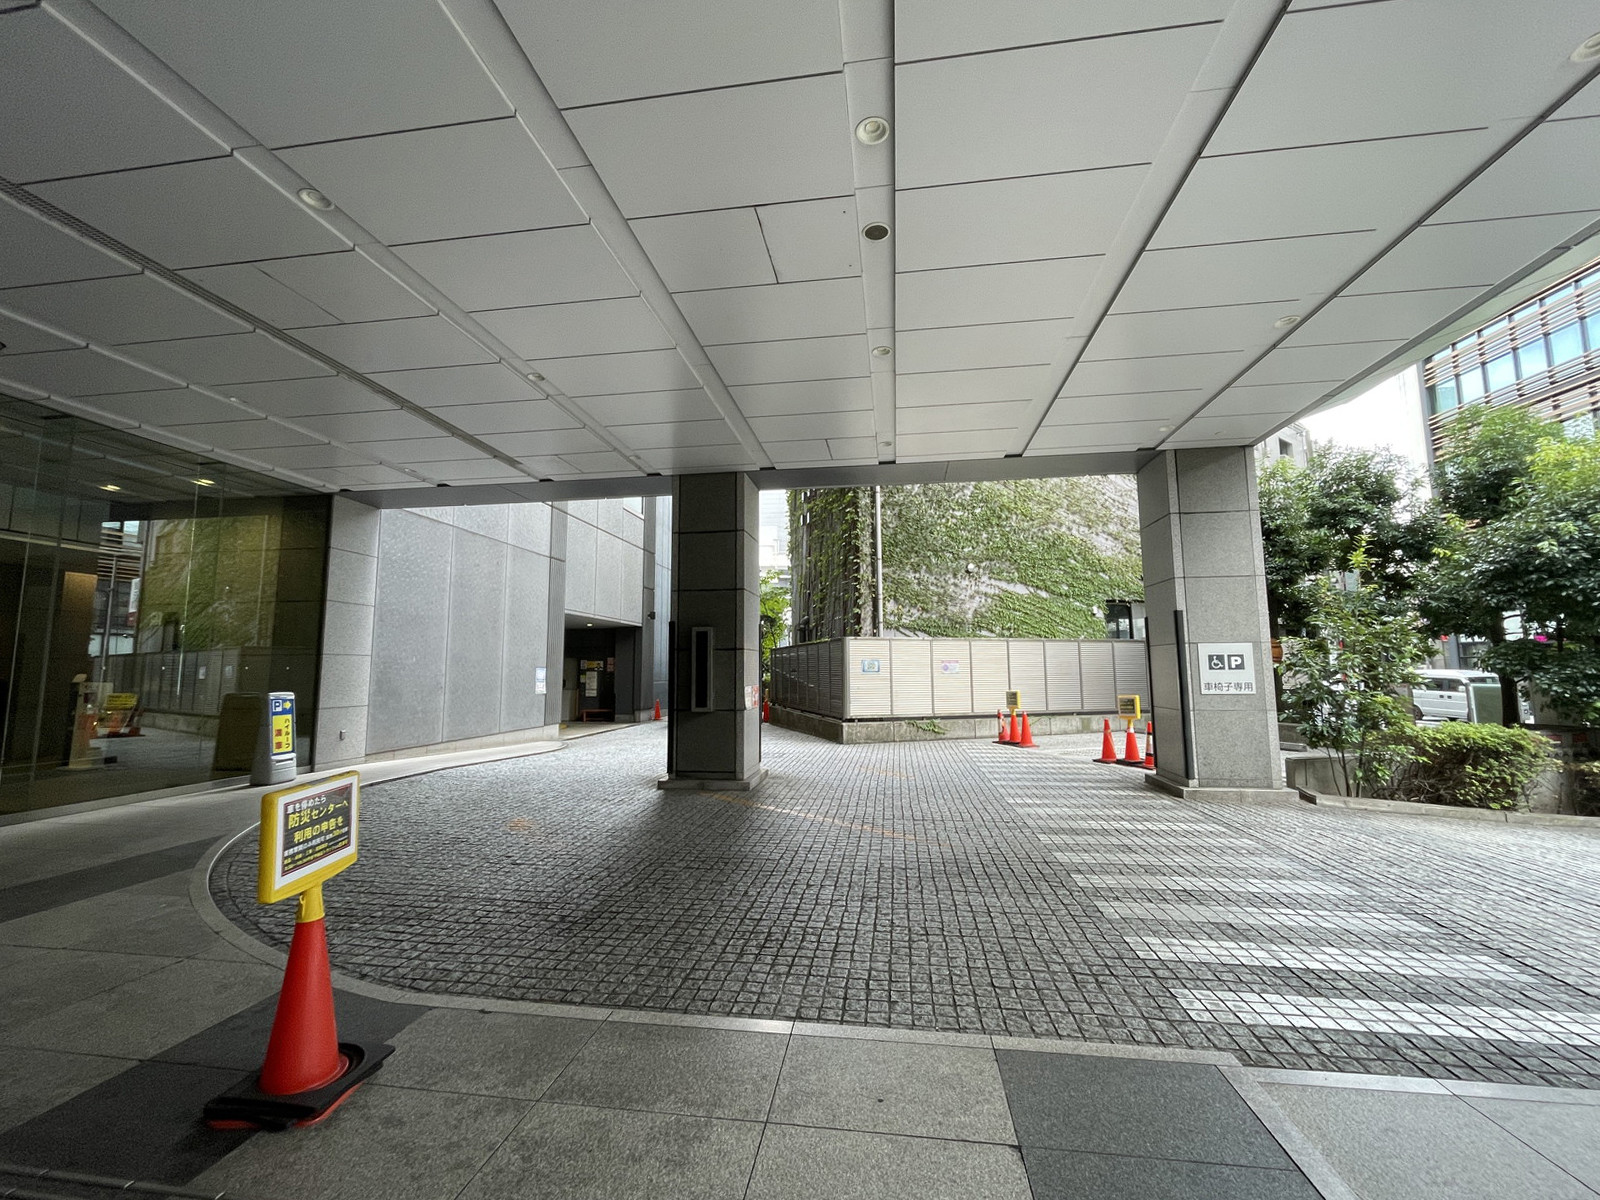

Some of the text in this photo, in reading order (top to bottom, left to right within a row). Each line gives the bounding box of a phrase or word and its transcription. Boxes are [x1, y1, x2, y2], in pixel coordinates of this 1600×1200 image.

[1230, 656, 1242, 669] P
[1203, 681, 1254, 692] 車椅子専用
[274, 701, 281, 711] P
[288, 800, 349, 829] 防災センターへ
[293, 815, 344, 844] 利用の申告を
